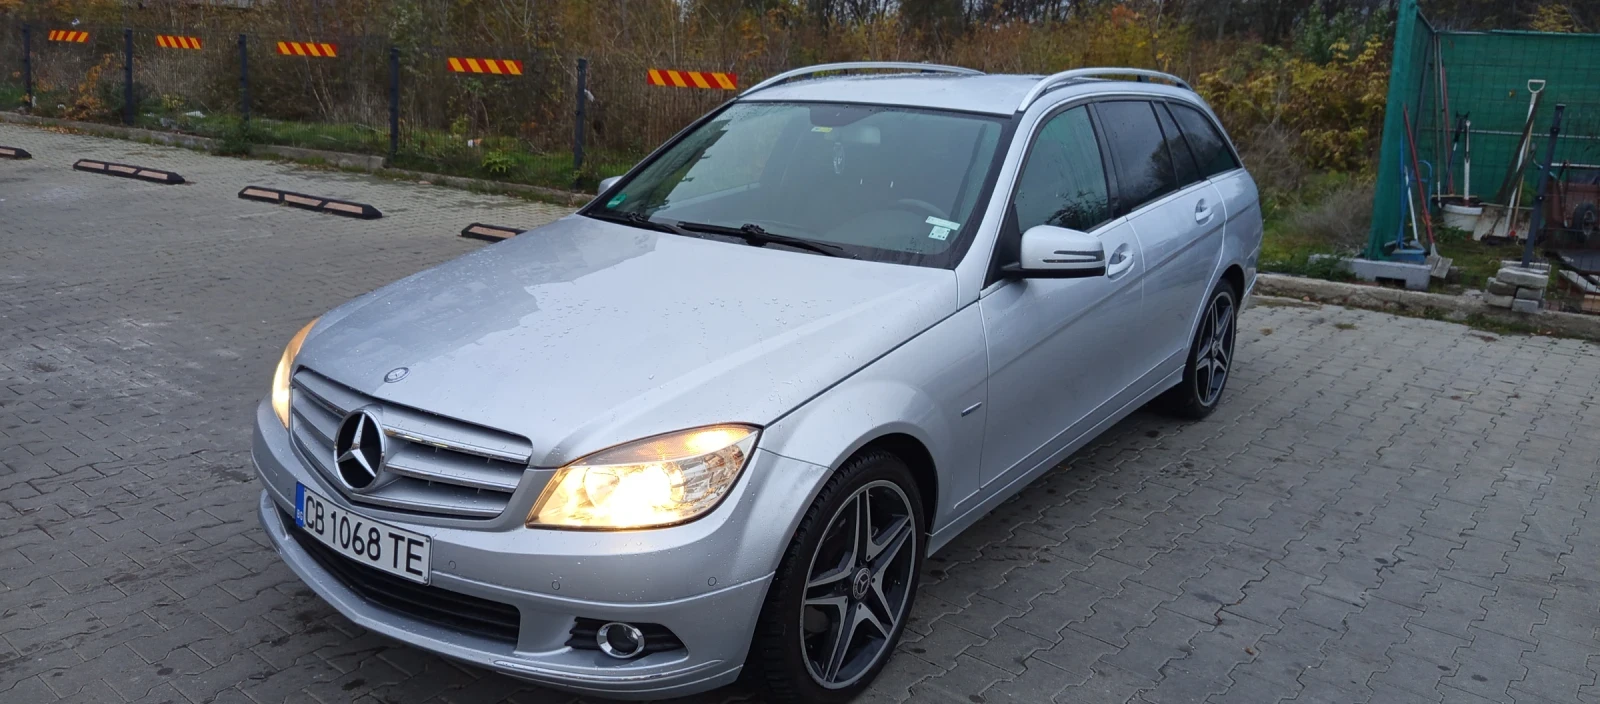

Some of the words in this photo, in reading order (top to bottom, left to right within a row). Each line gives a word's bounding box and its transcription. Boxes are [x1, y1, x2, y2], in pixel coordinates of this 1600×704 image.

[305, 495, 325, 536] CB
[330, 510, 381, 562] 1068
[388, 532, 425, 577] TE
